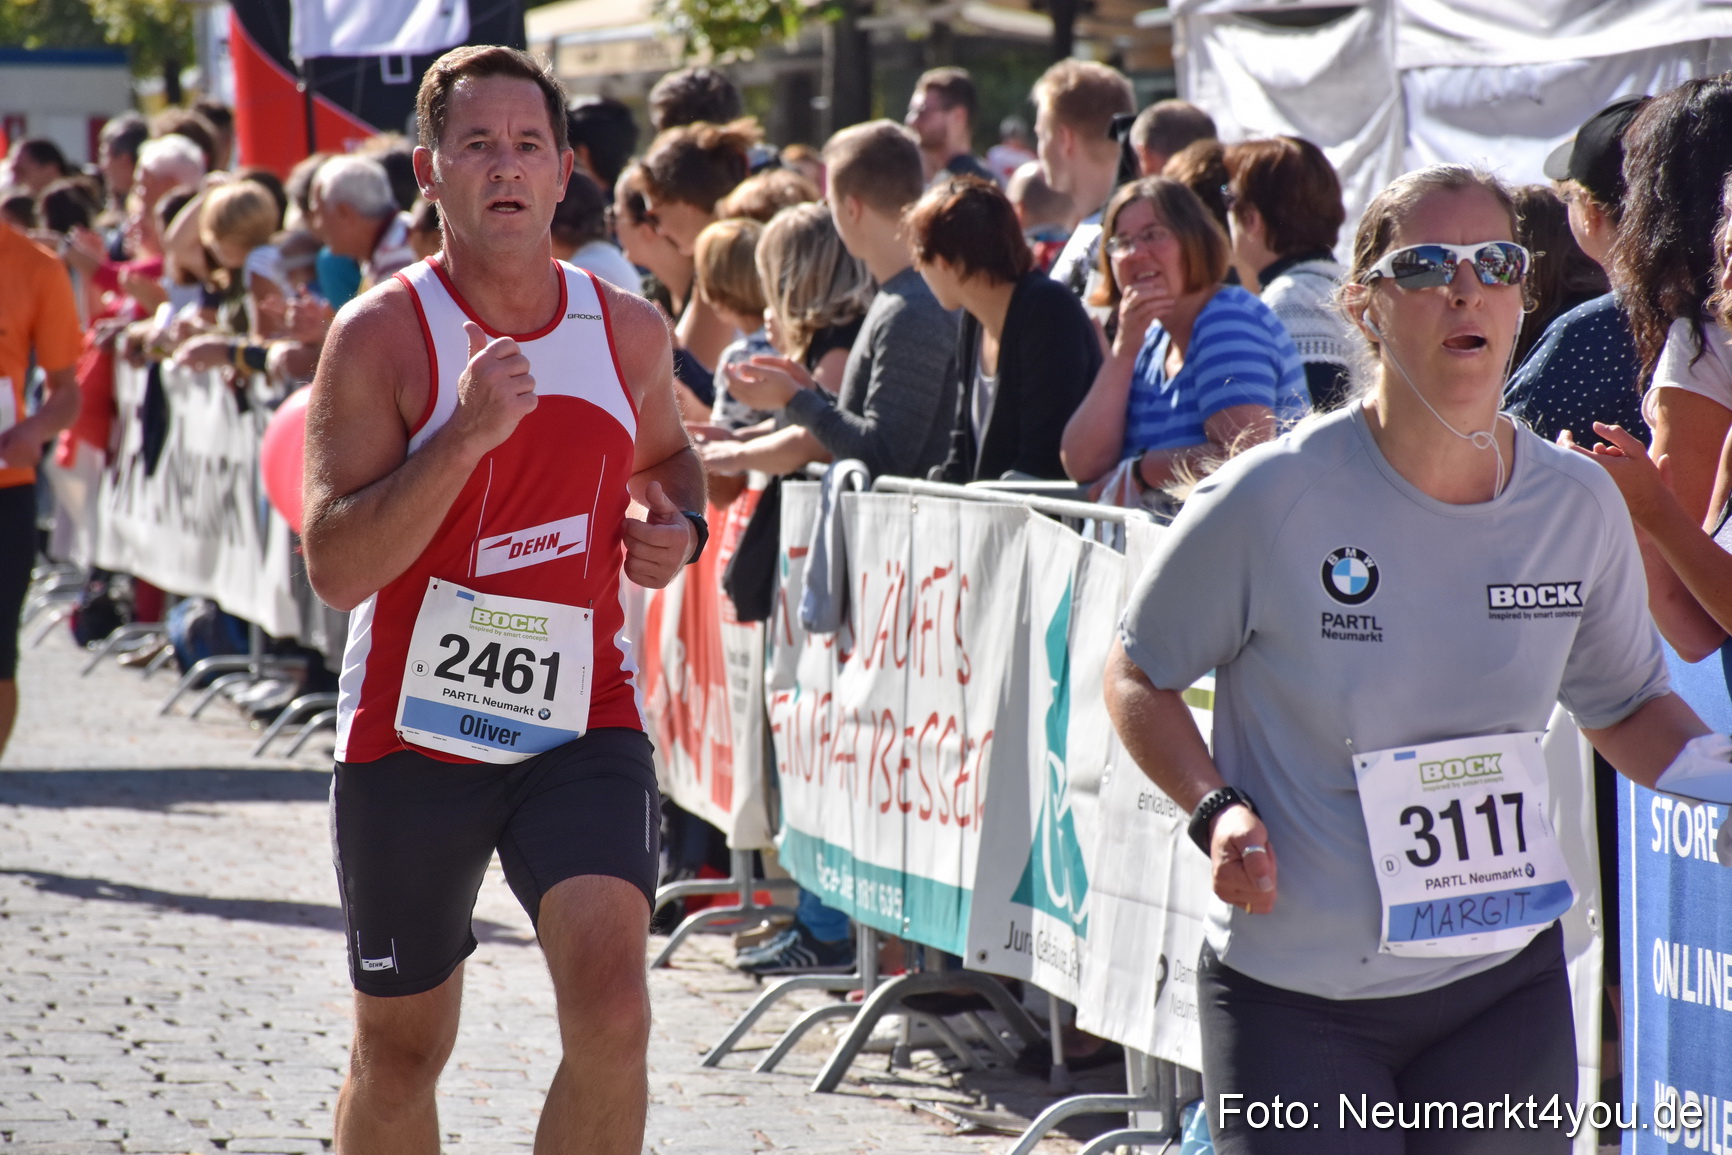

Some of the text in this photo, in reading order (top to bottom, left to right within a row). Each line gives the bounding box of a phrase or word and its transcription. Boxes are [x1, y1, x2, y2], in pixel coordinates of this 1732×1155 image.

[508, 531, 561, 560] DEHN
[1487, 581, 1583, 610] BOCK
[471, 607, 549, 634] BOCK
[1321, 611, 1383, 631] PARTL
[1488, 612, 1522, 621] inspired
[1523, 612, 1532, 620] by
[1533, 611, 1553, 619] smart
[469, 624, 494, 634] inspired
[503, 631, 521, 639] smart
[522, 633, 549, 642] concepts
[1321, 627, 1383, 642] Neumarkt
[416, 664, 424, 673] B
[433, 633, 560, 702] 2461
[442, 687, 534, 717] PARTL Neumarkt
[459, 713, 521, 746] Oliver
[1420, 753, 1502, 784] BOCK
[1399, 792, 1527, 868] 3117
[1651, 796, 1720, 863] STORE
[1386, 860, 1394, 872] D
[1425, 867, 1524, 891] PARTL Neumarkt
[1410, 891, 1532, 940] MARGIT
[1652, 937, 1732, 1012] ONLINE
